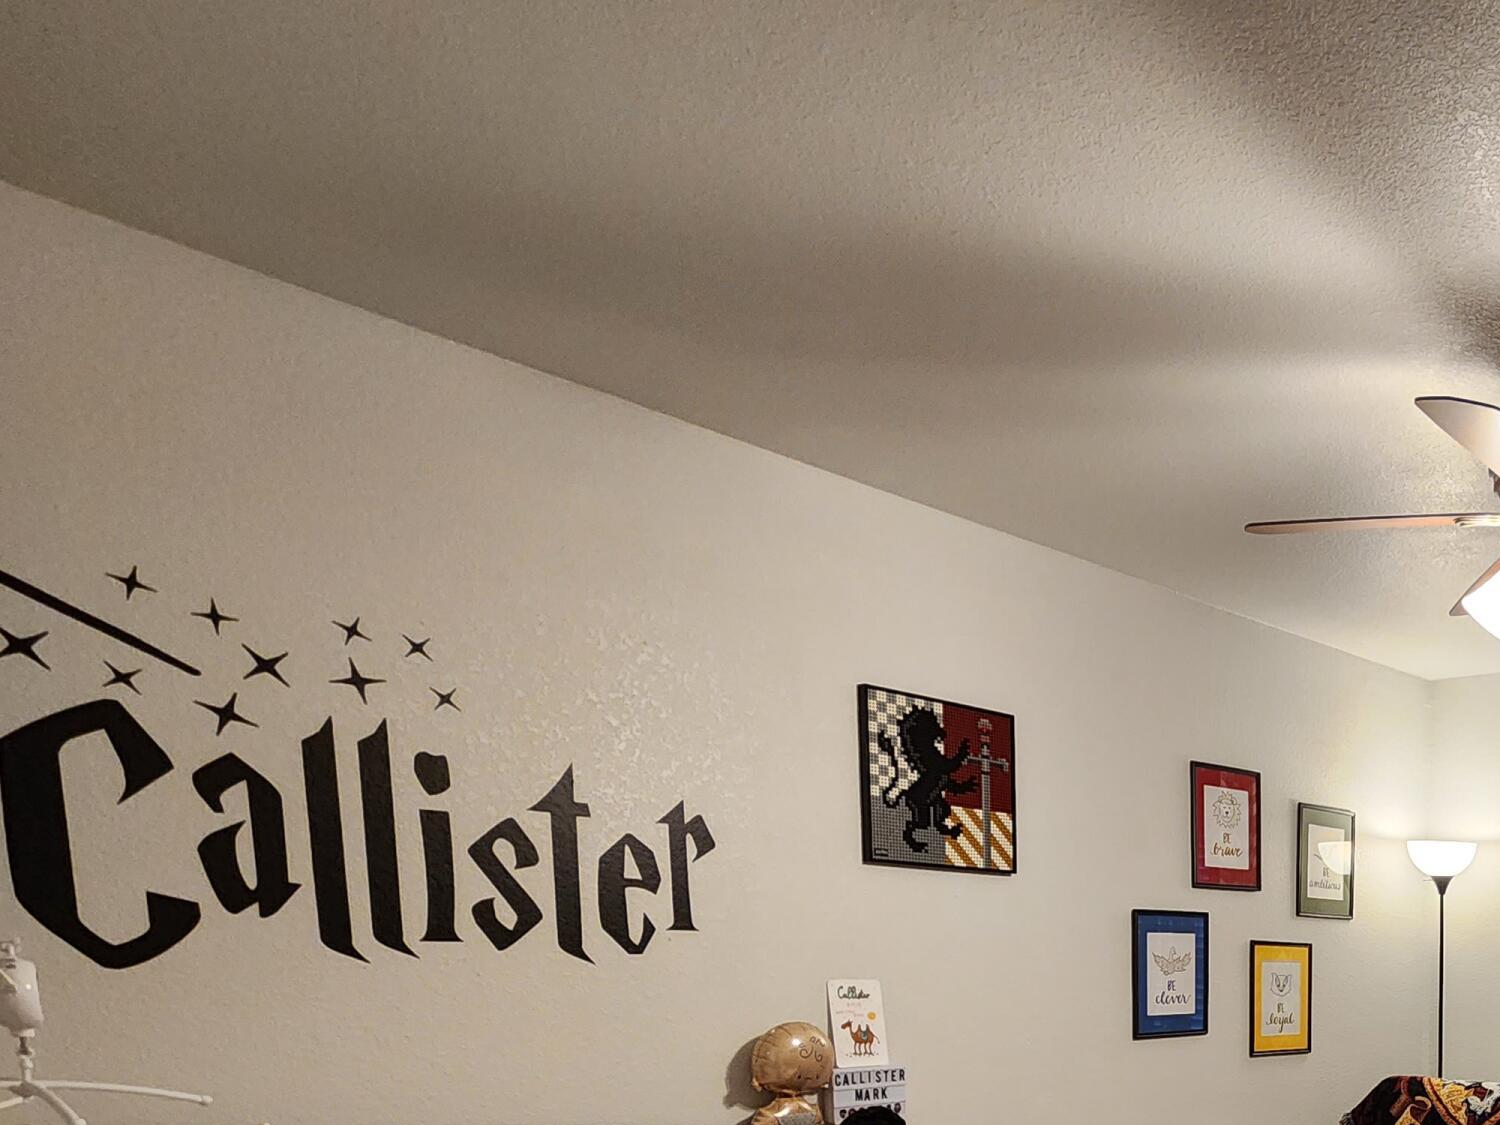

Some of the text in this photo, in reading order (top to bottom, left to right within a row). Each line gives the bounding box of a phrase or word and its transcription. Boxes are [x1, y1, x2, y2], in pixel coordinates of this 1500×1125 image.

[0, 699, 716, 969] Callister
[1222, 832, 1232, 844] BE
[1211, 842, 1243, 857] brave
[1167, 979, 1176, 991] BE
[1155, 991, 1192, 1005] clever
[1277, 1002, 1285, 1014] BE
[1266, 1012, 1295, 1033] loyal
[834, 1069, 906, 1087] CALLISTER
[854, 1087, 888, 1102] MARK
